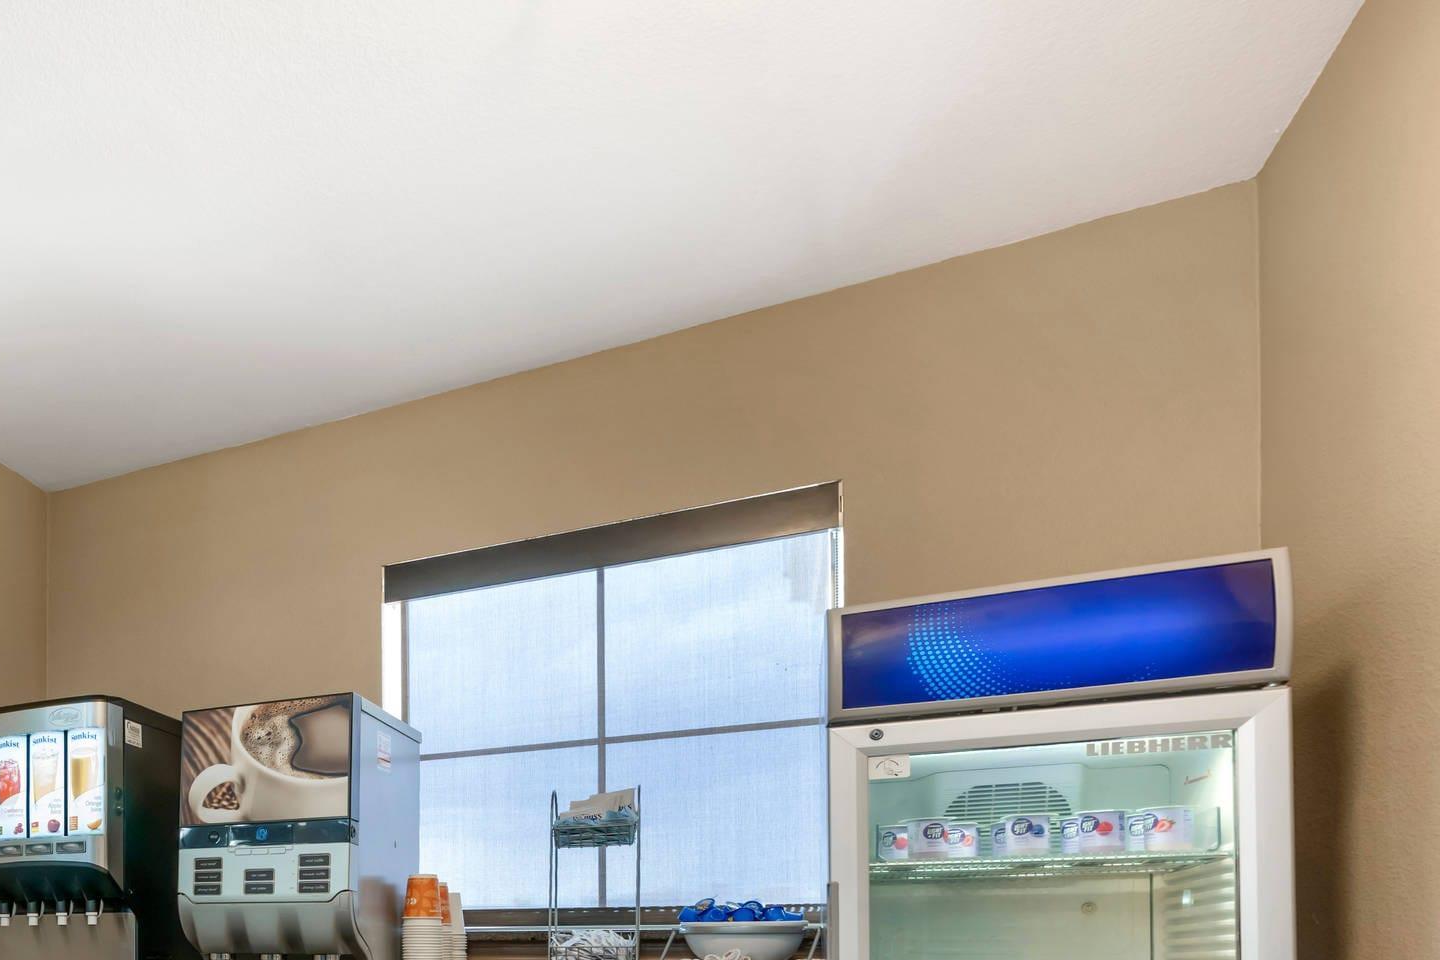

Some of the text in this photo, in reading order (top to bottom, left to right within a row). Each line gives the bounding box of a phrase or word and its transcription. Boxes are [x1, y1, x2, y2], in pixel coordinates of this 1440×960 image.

[32, 734, 58, 745] sunkist
[71, 731, 98, 742] sunkist
[1086, 733, 1232, 757] LIEBHERR
